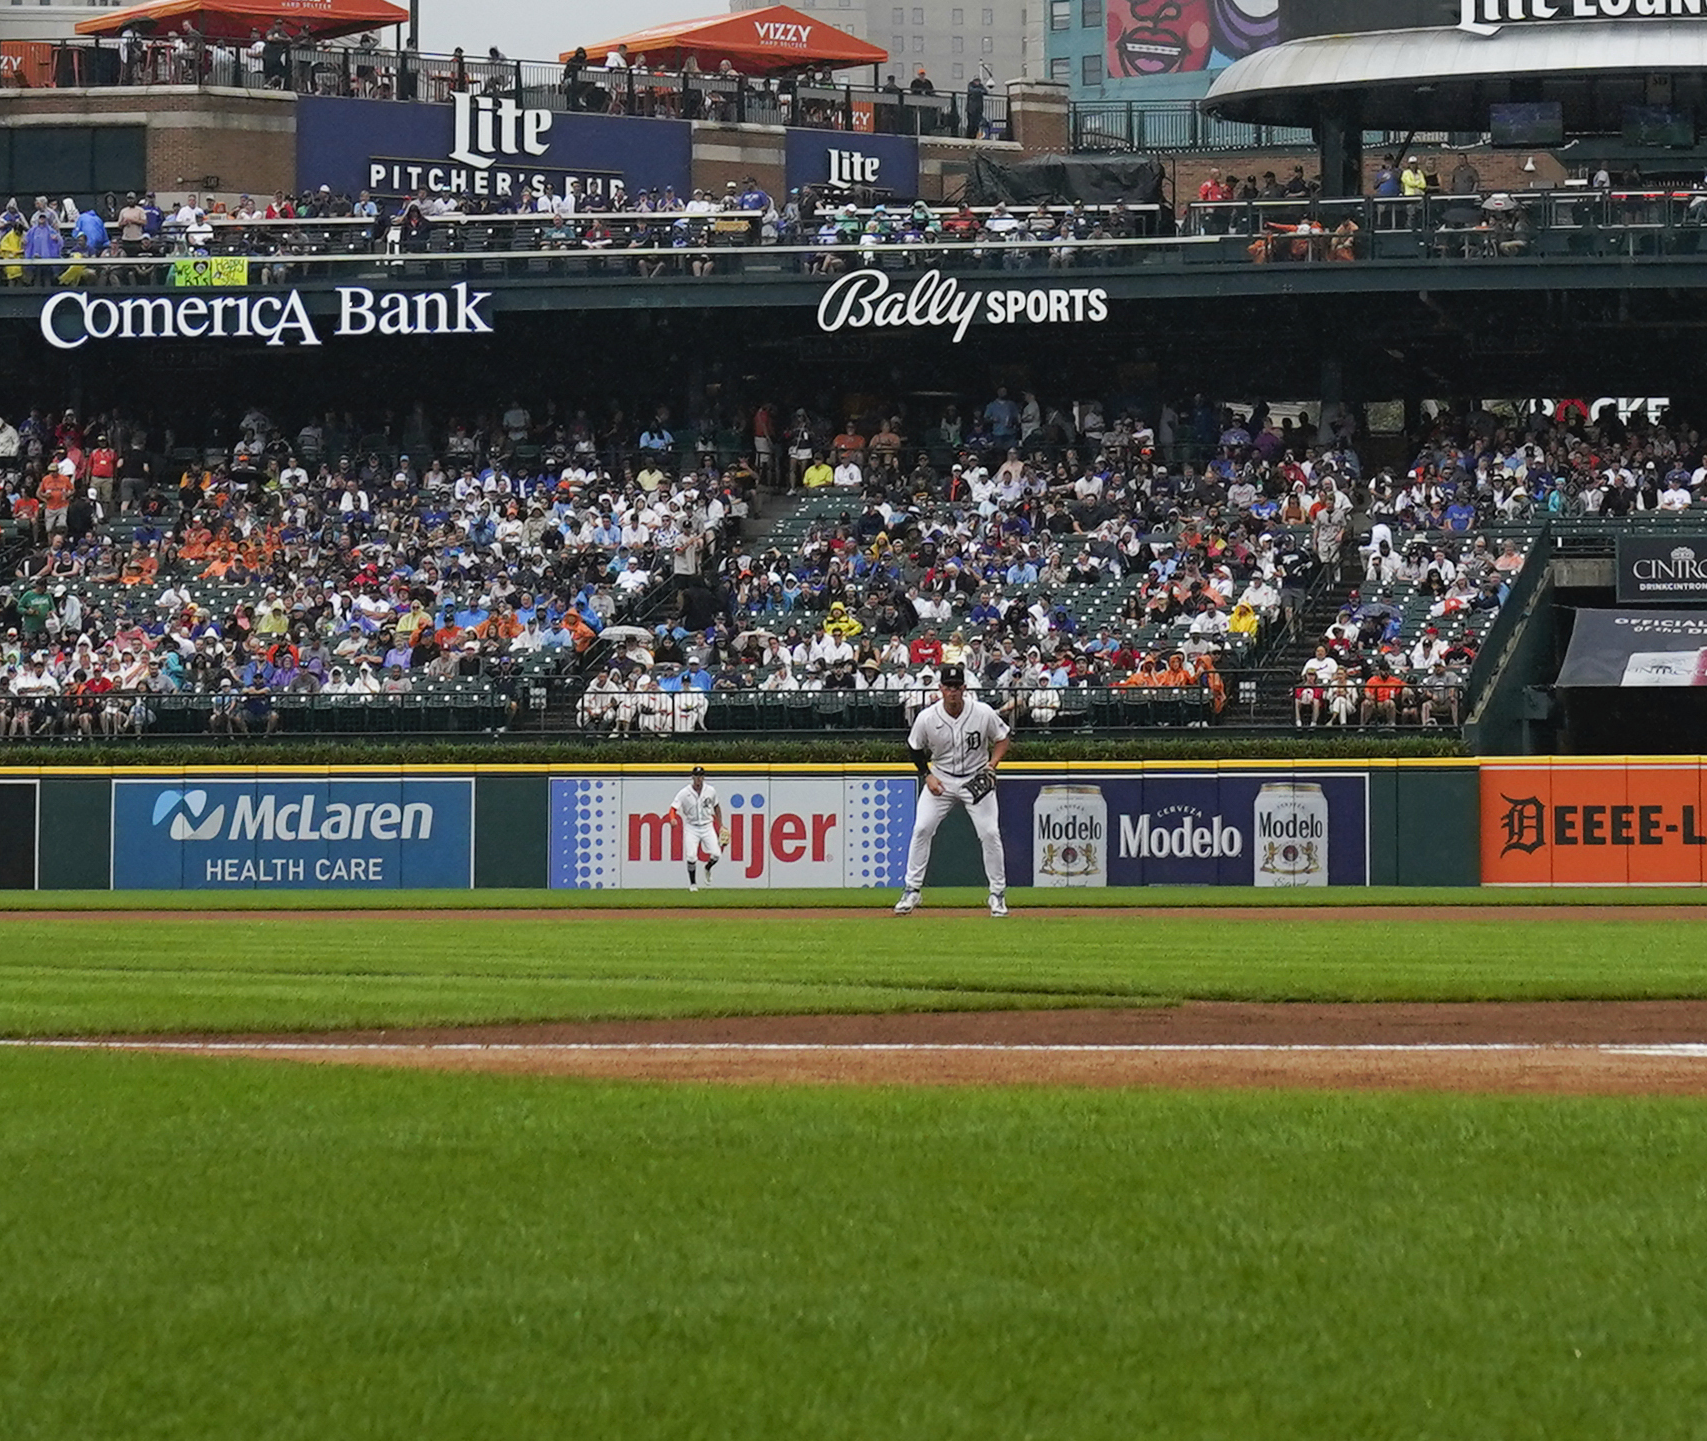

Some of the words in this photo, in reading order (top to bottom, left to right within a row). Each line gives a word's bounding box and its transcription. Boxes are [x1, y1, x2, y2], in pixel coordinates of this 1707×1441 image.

[754, 21, 813, 42] VIZZY
[448, 91, 553, 170] Lite
[369, 163, 546, 198] PITCHER'S
[827, 148, 881, 190] Lite
[334, 283, 494, 336] Bank
[816, 268, 985, 343] Bally
[986, 287, 1108, 325] SPORTS
[228, 793, 434, 843] McLaren
[1038, 813, 1103, 841] Modelo
[1157, 805, 1203, 819] CERVEZA
[1259, 811, 1323, 839] Modelo
[1119, 813, 1243, 859] Modelo
[205, 858, 304, 882] HEALTH
[314, 857, 383, 882] CARE
